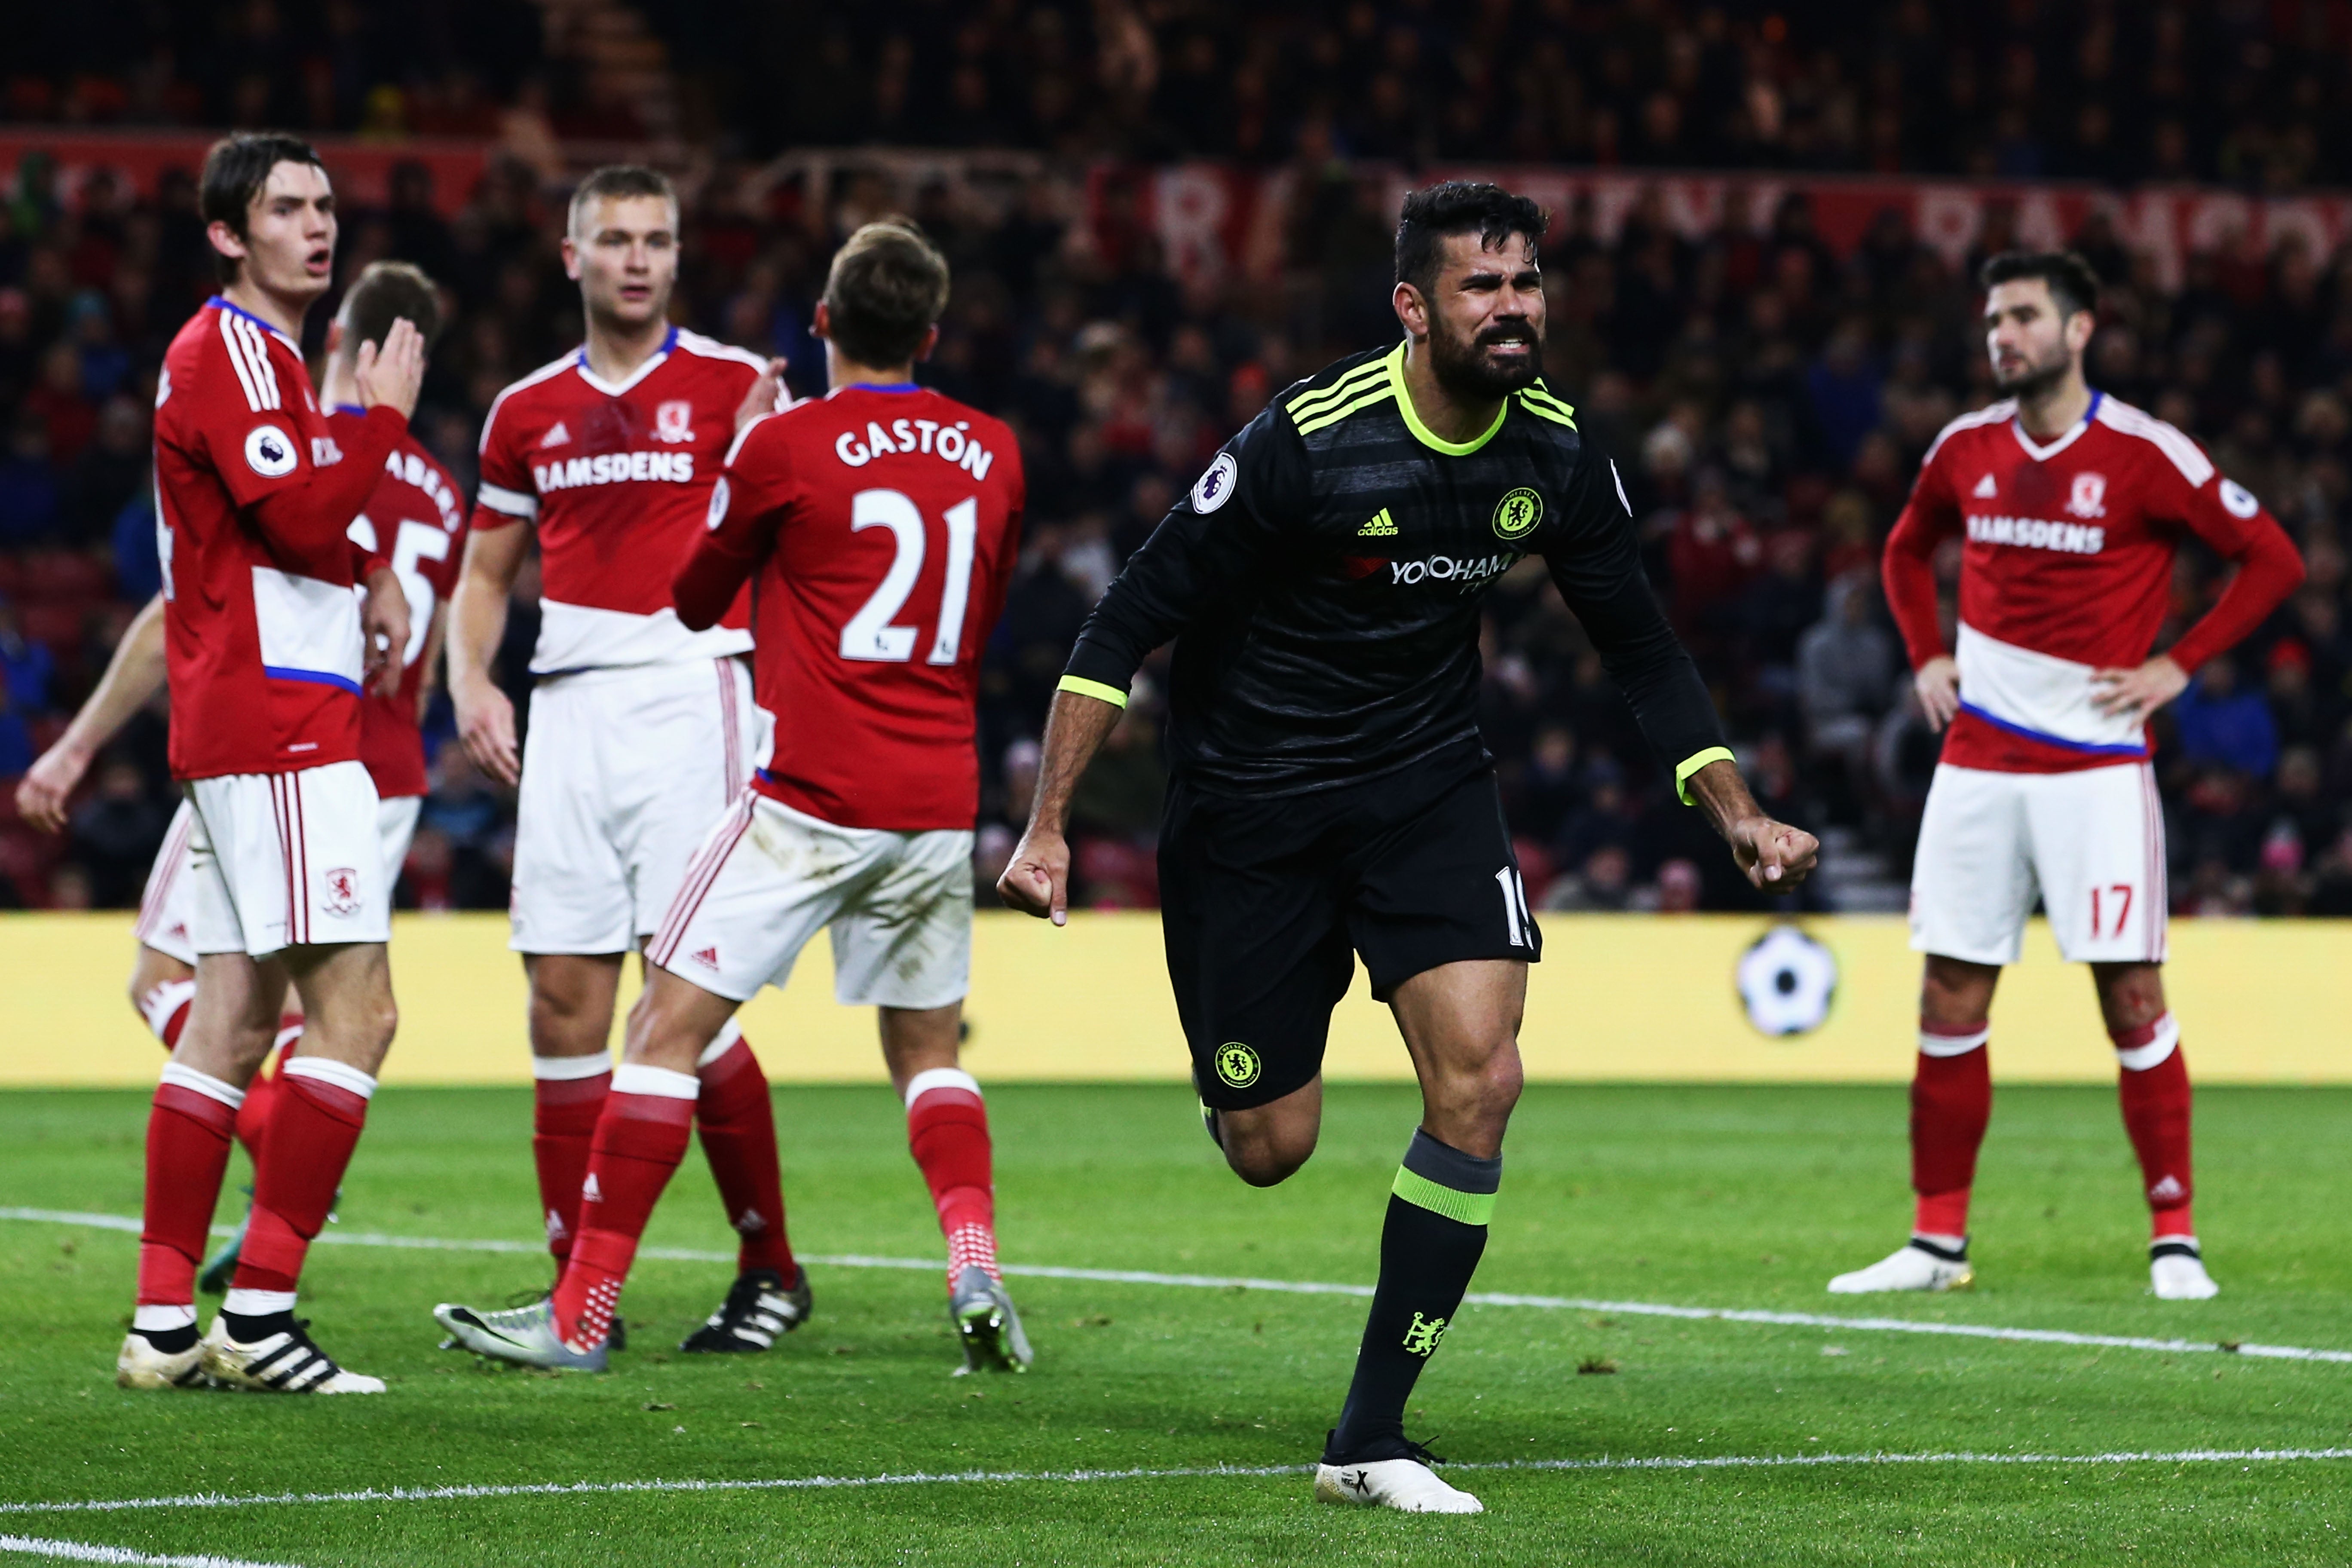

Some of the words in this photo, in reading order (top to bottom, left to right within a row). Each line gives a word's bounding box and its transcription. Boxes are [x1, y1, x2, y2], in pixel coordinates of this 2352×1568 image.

[836, 419, 993, 481] GASTÓN
[534, 451, 694, 493] RAMSDENS
[1358, 526, 1398, 536] adidas
[1967, 515, 2104, 555] RAMSDENS
[839, 488, 978, 665] 21
[1391, 553, 1524, 584] YOOHAM
[2090, 884, 2133, 940] 17
